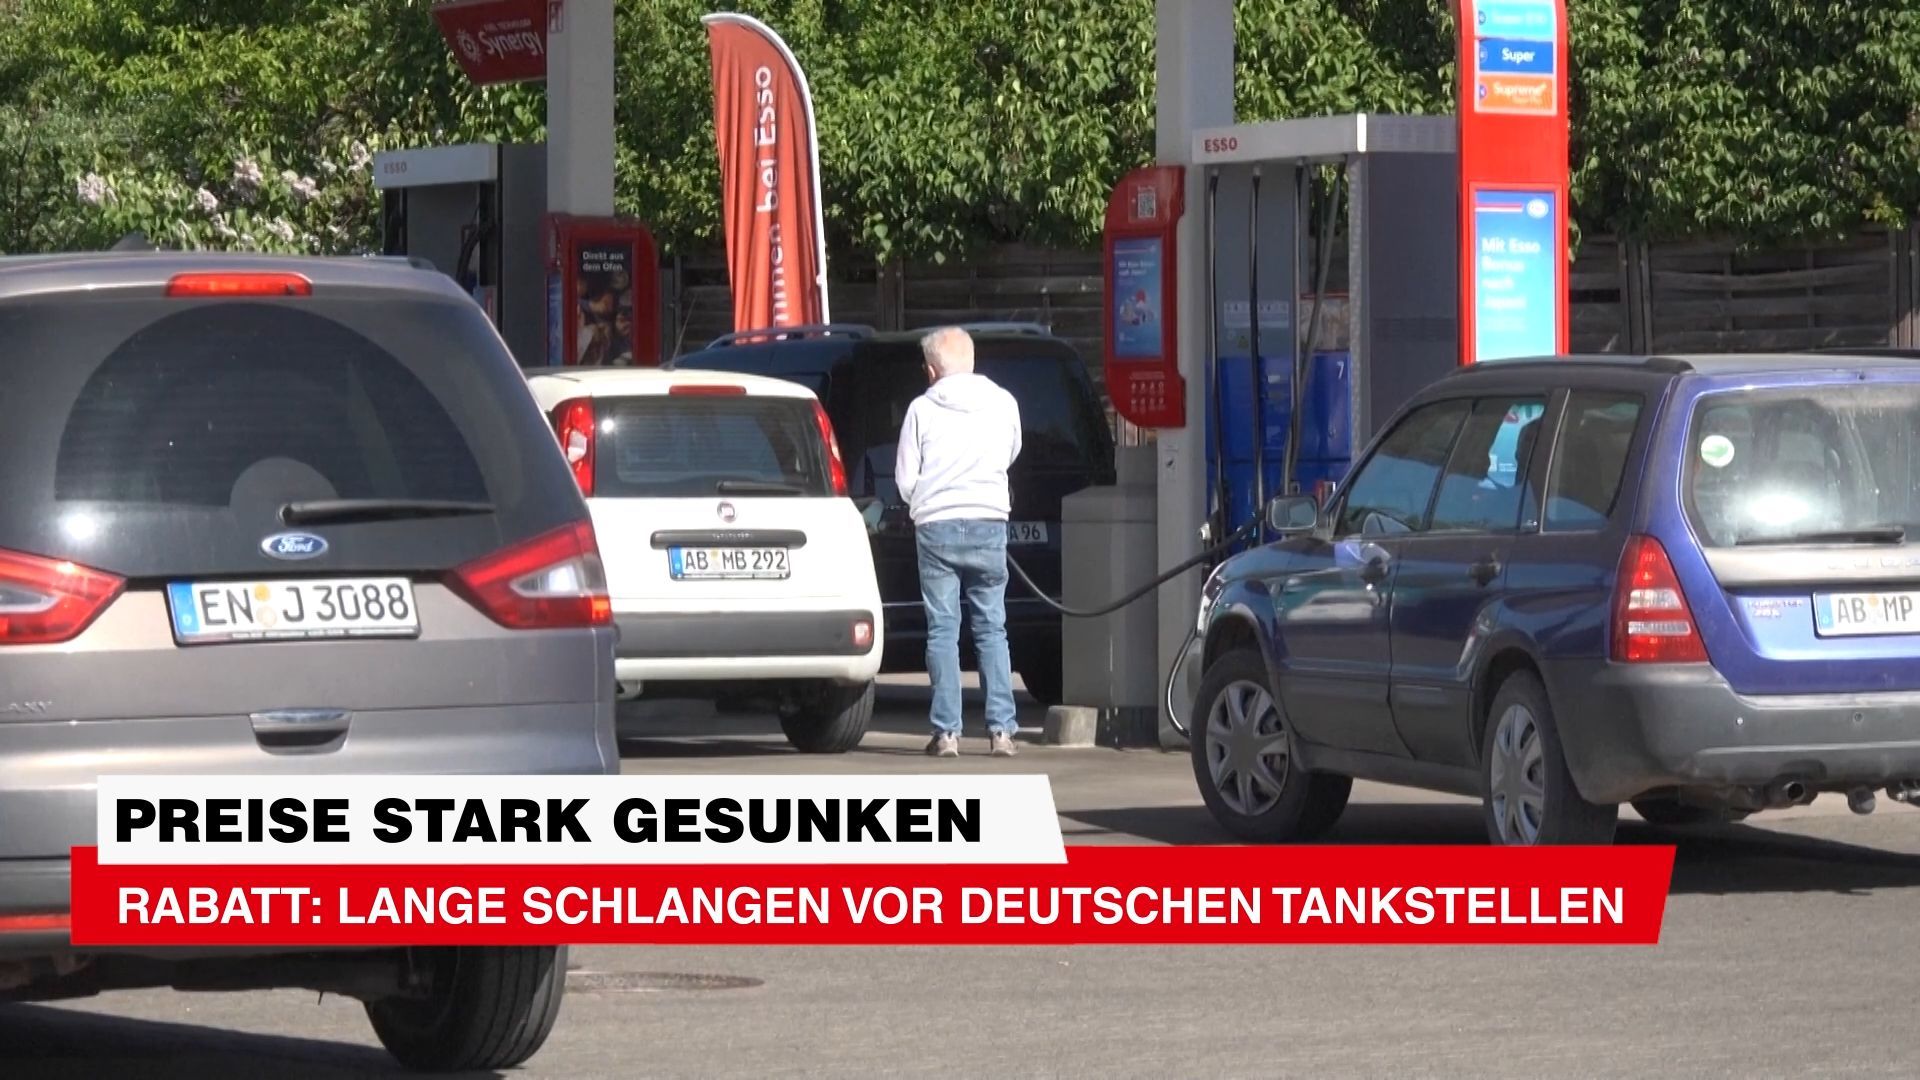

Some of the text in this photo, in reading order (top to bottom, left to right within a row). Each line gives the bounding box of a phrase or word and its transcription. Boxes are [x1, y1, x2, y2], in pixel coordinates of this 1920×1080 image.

[478, 31, 544, 60] Synergy
[1502, 47, 1535, 64] Super
[755, 65, 776, 146] Esso
[1204, 137, 1238, 152] ESSO
[756, 159, 779, 213] bei
[1482, 237, 1541, 254] Mit Esso
[582, 251, 625, 261] Direkt aus
[582, 262, 623, 272] dem Ofen
[1336, 360, 1345, 380] 7
[1021, 524, 1041, 540] 96
[278, 536, 315, 553] Ford
[685, 551, 786, 570] AB MB 292
[200, 583, 409, 626] EN J 3088
[1837, 595, 1913, 624] AB MP
